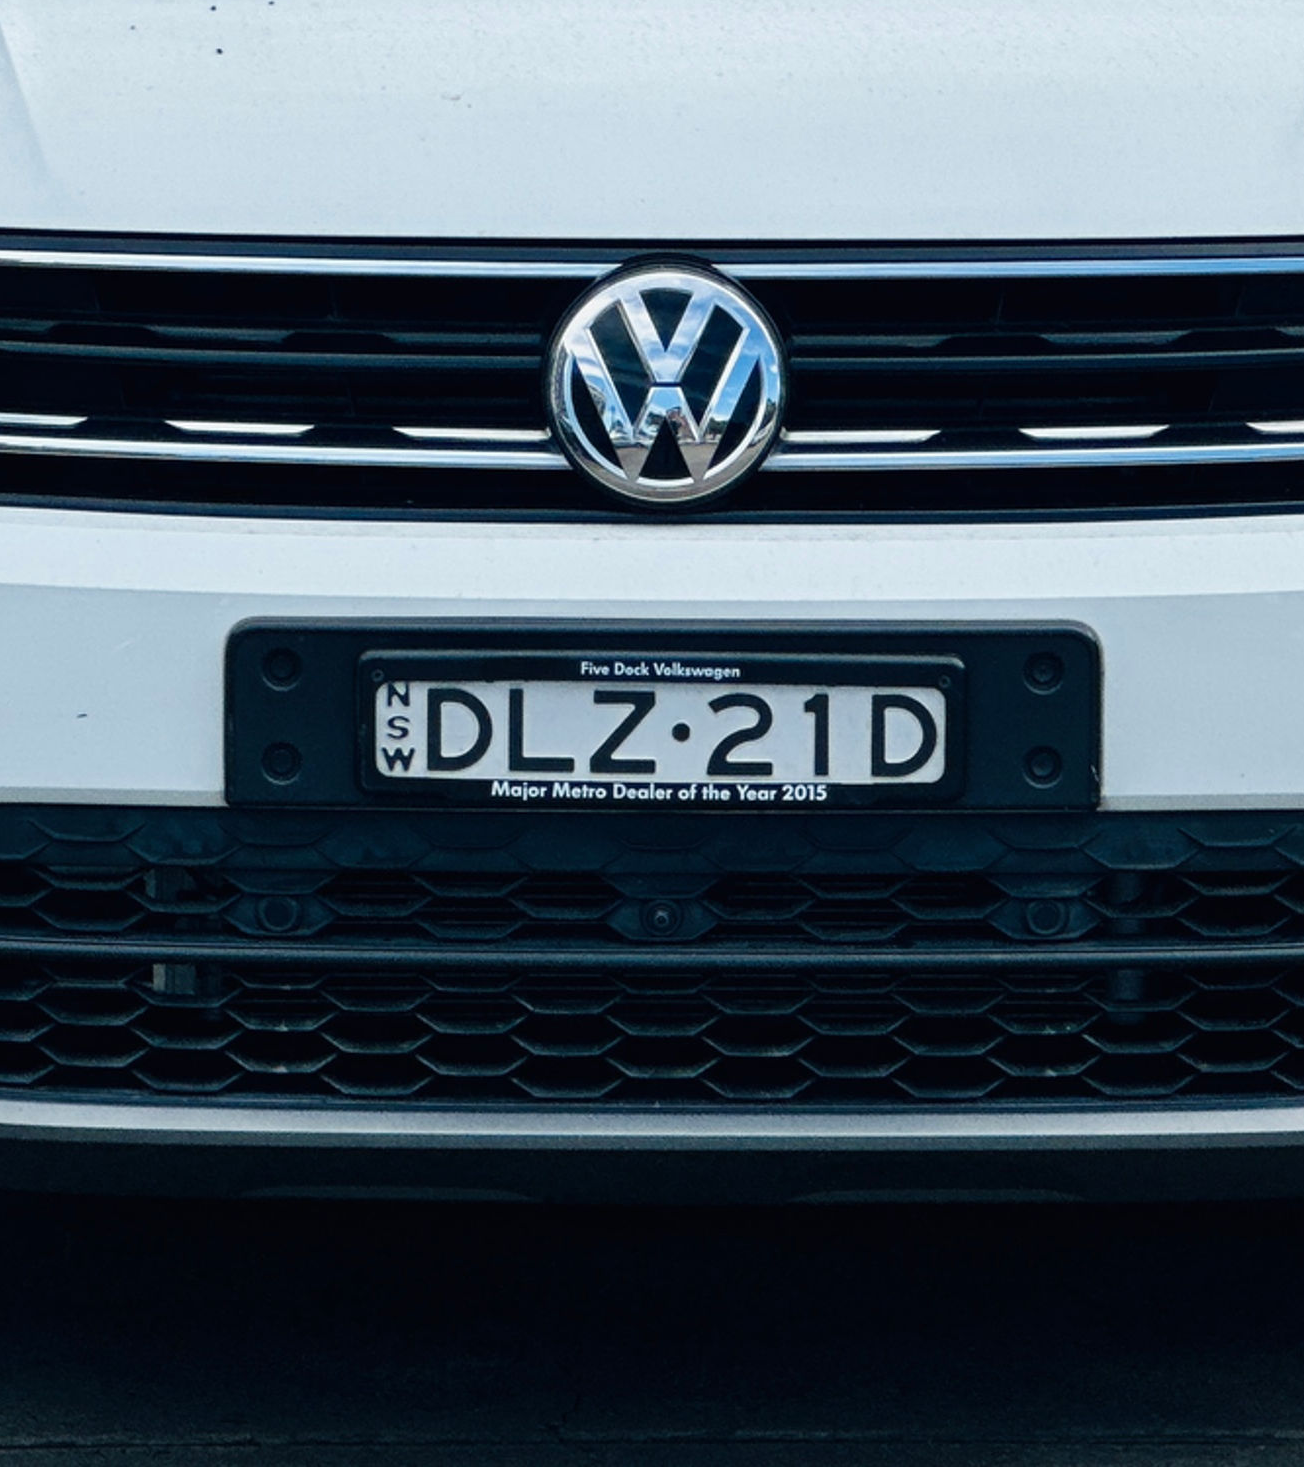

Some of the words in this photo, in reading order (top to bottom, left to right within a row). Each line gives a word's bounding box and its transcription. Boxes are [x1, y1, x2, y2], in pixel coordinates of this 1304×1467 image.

[580, 661, 610, 676] Five
[614, 661, 650, 676] Dock
[653, 662, 741, 681] Volkswagen
[491, 782, 547, 800] Major
[552, 783, 607, 799] Metro
[612, 784, 671, 800] Dealer
[677, 784, 697, 800] of
[701, 785, 731, 800] the
[735, 785, 776, 801] Year
[781, 785, 828, 801] 2015
